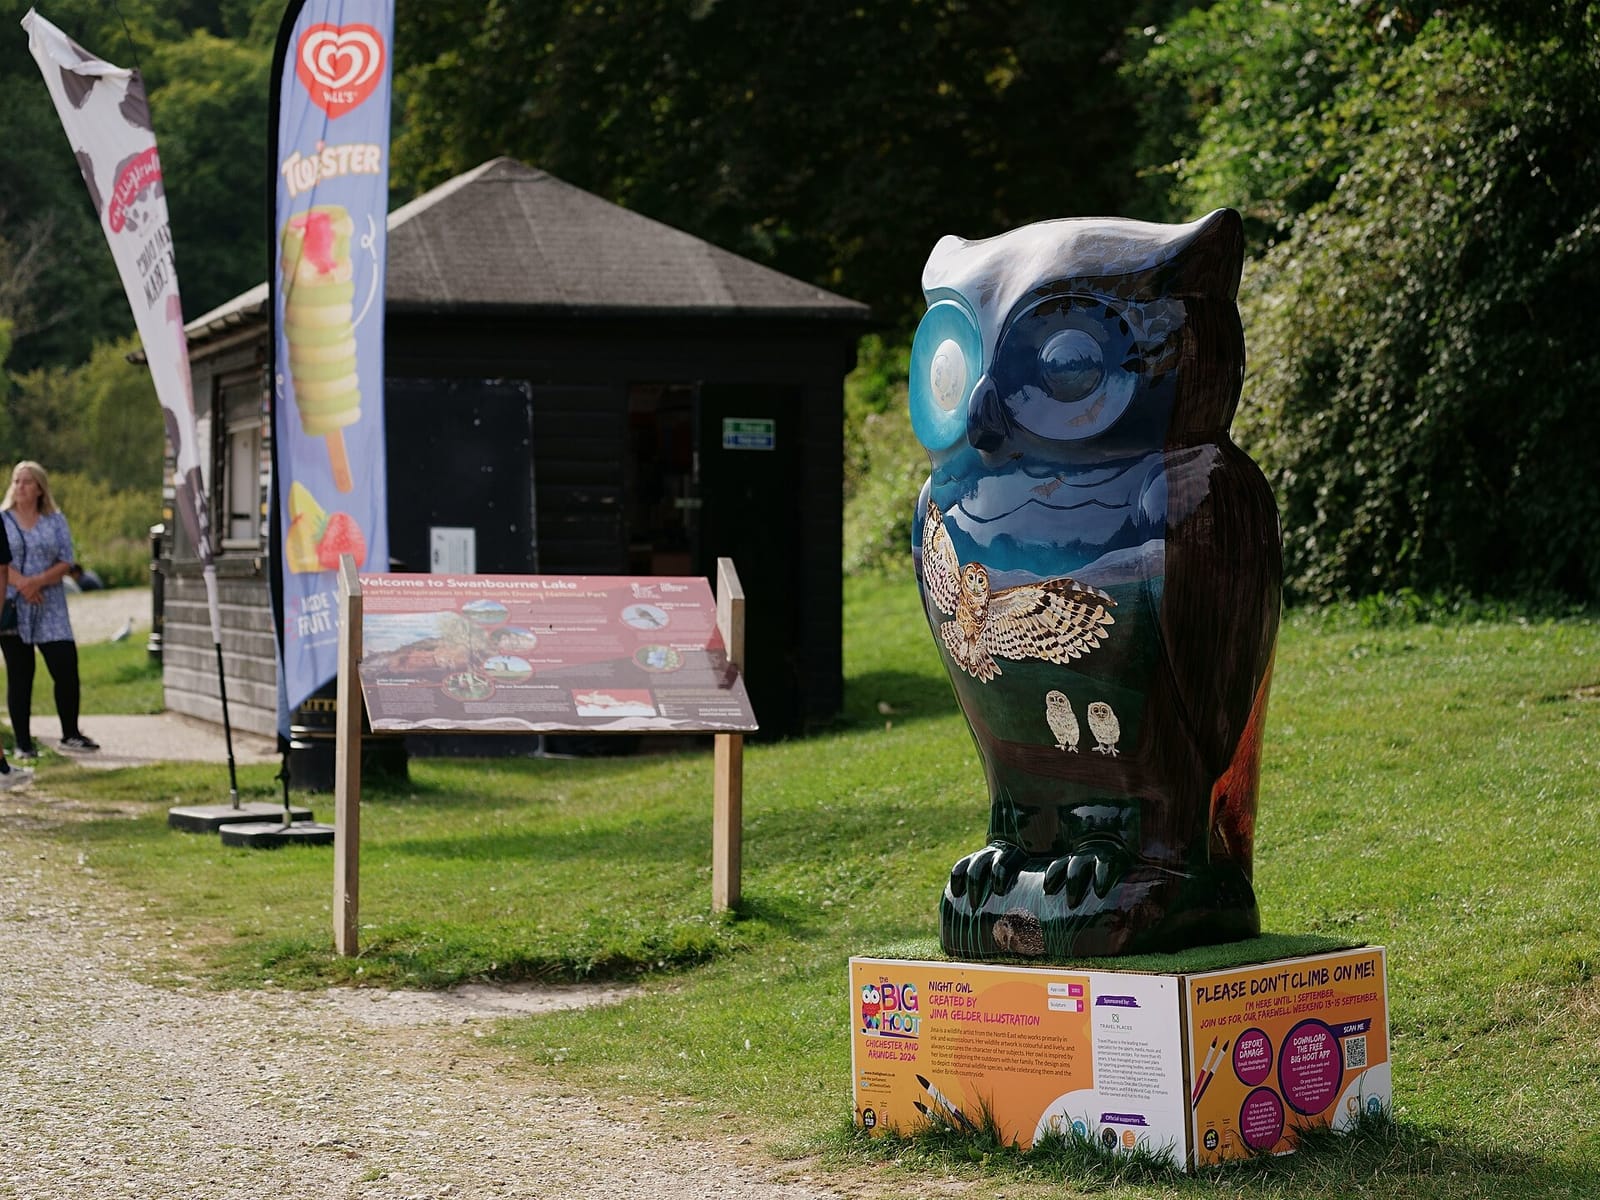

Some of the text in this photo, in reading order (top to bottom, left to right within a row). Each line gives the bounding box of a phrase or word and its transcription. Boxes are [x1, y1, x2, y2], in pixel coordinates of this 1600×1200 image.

[428, 578, 444, 588] to
[447, 578, 538, 589] Swanbourne
[542, 580, 576, 589] Lake
[929, 981, 973, 993] NIGHT OWL
[1197, 960, 1375, 1005] PLEASE DON'T CLIMB ON ME!
[881, 984, 918, 1011] BIG
[929, 995, 977, 1008] CREATED BY
[1245, 1001, 1254, 1012] I'M
[1256, 998, 1272, 1009] HERE
[1274, 995, 1292, 1007] UNTIL
[1298, 989, 1334, 1003] SEPTEMBER
[1200, 1017, 1216, 1029] JOIN
[1218, 1015, 1227, 1025] US
[1228, 1013, 1242, 1024] FOR
[1243, 1011, 1257, 1022] OUR
[1258, 1007, 1291, 1021] FAREWELL
[1292, 1002, 1323, 1015] WEEKEND
[1342, 993, 1378, 1008] SEPTEMBER
[883, 1012, 921, 1034] HOOT
[930, 1009, 1040, 1026] JINA GELDER ILLUSTRATION
[1344, 1025, 1356, 1033] SCAN
[866, 1040, 919, 1051] CHICHESTER AND
[1241, 1038, 1263, 1050] REPORT
[1294, 1034, 1326, 1046] DOWNLOAD
[1240, 1048, 1264, 1058] DAMAGE
[1297, 1042, 1323, 1054] THE FREE
[868, 1050, 916, 1061] ARUNDEL 2024
[1302, 1052, 1318, 1061] HOOT
[1319, 1050, 1330, 1059] APP
